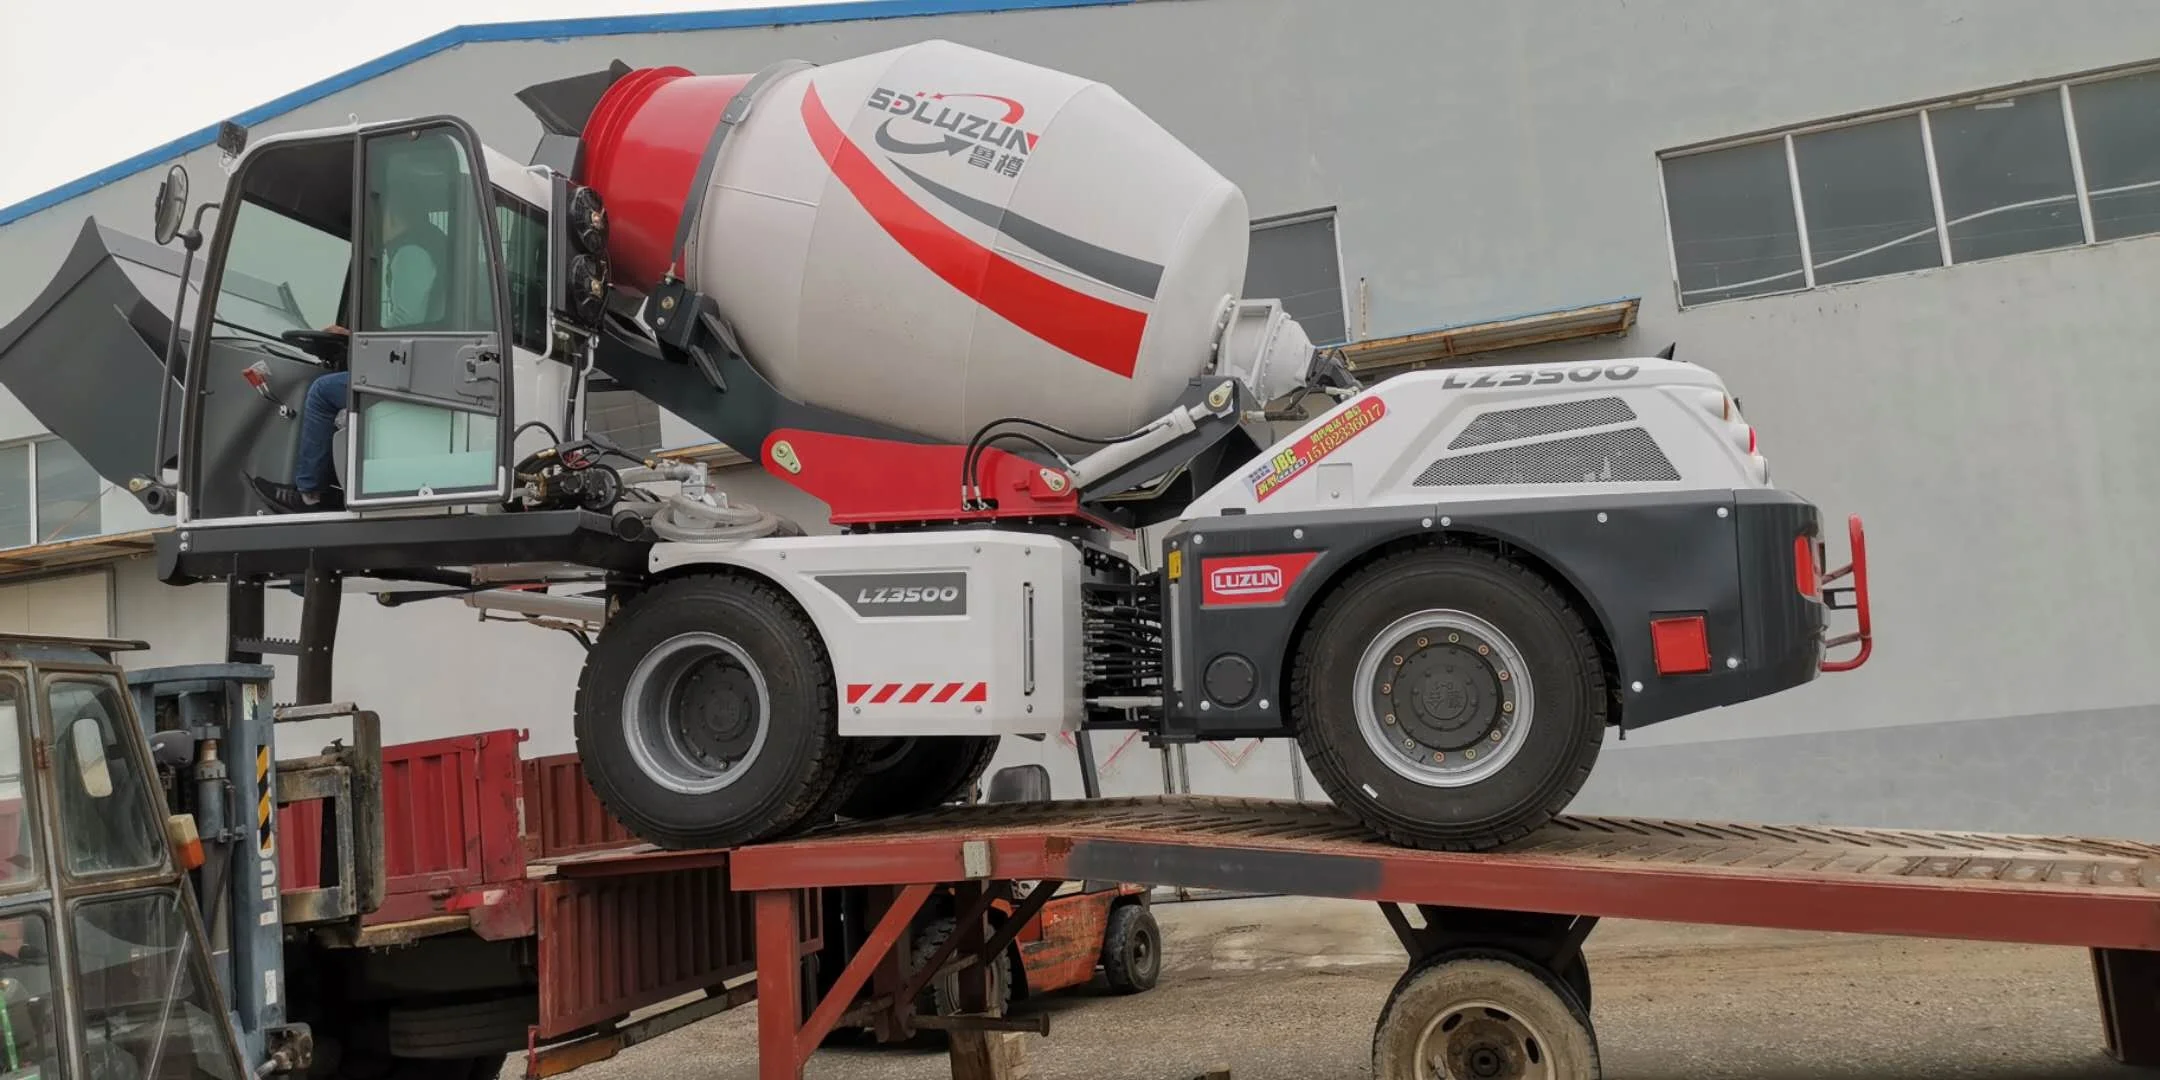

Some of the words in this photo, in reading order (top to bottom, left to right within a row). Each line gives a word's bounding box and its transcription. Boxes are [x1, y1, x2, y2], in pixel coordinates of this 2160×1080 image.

[867, 87, 1039, 155] SDLUZUN
[968, 145, 1025, 178] 鲁樽
[1442, 365, 1639, 389] LZ3500
[1306, 403, 1381, 465] 15192336017
[1214, 571, 1279, 589] LUZUN
[856, 586, 960, 604] LZ3500
